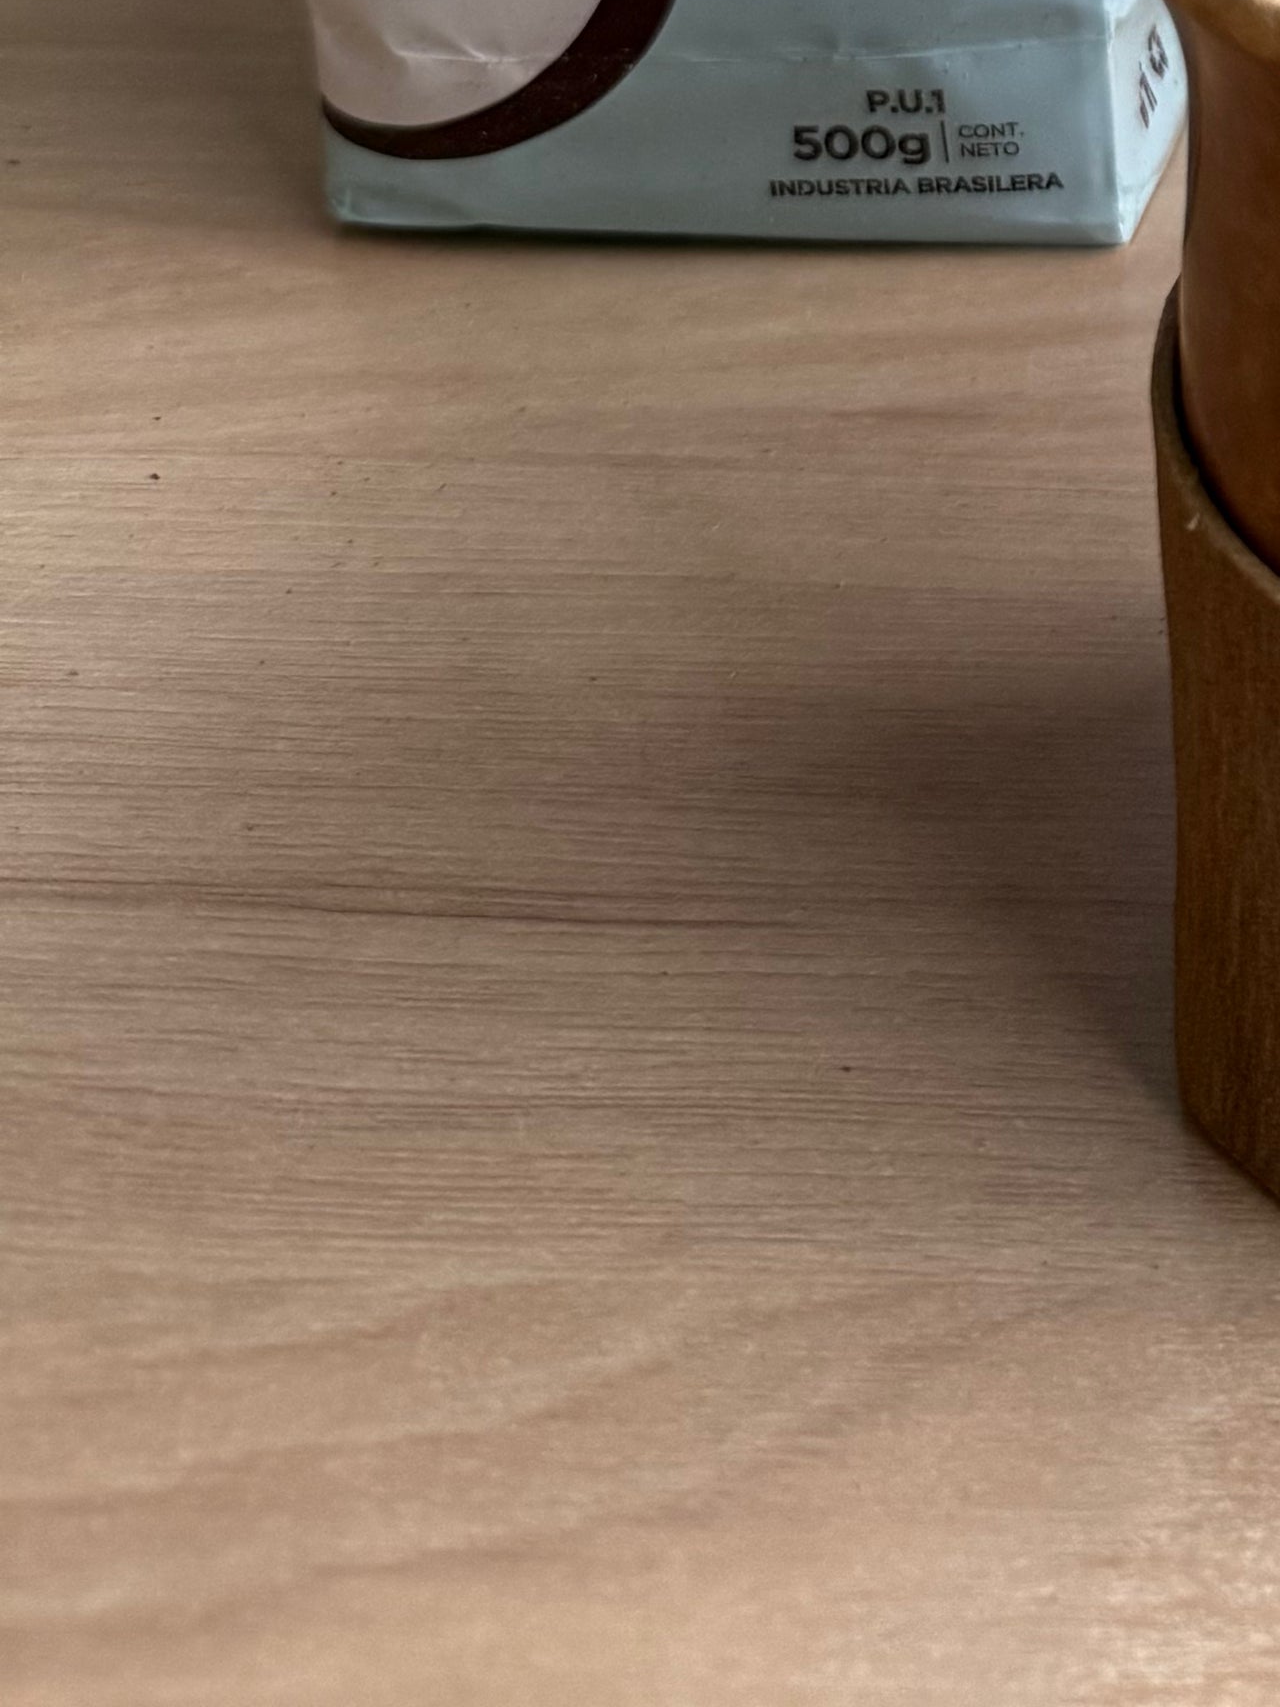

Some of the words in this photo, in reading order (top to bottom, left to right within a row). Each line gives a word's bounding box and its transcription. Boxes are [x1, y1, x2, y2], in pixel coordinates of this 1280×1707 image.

[866, 88, 945, 114] P.U.1
[957, 121, 1025, 139] CONT.
[793, 123, 931, 165] 500g
[960, 141, 1020, 157] NETO
[770, 177, 908, 198] INDUSTRIA
[917, 171, 1064, 196] BRASILERA
